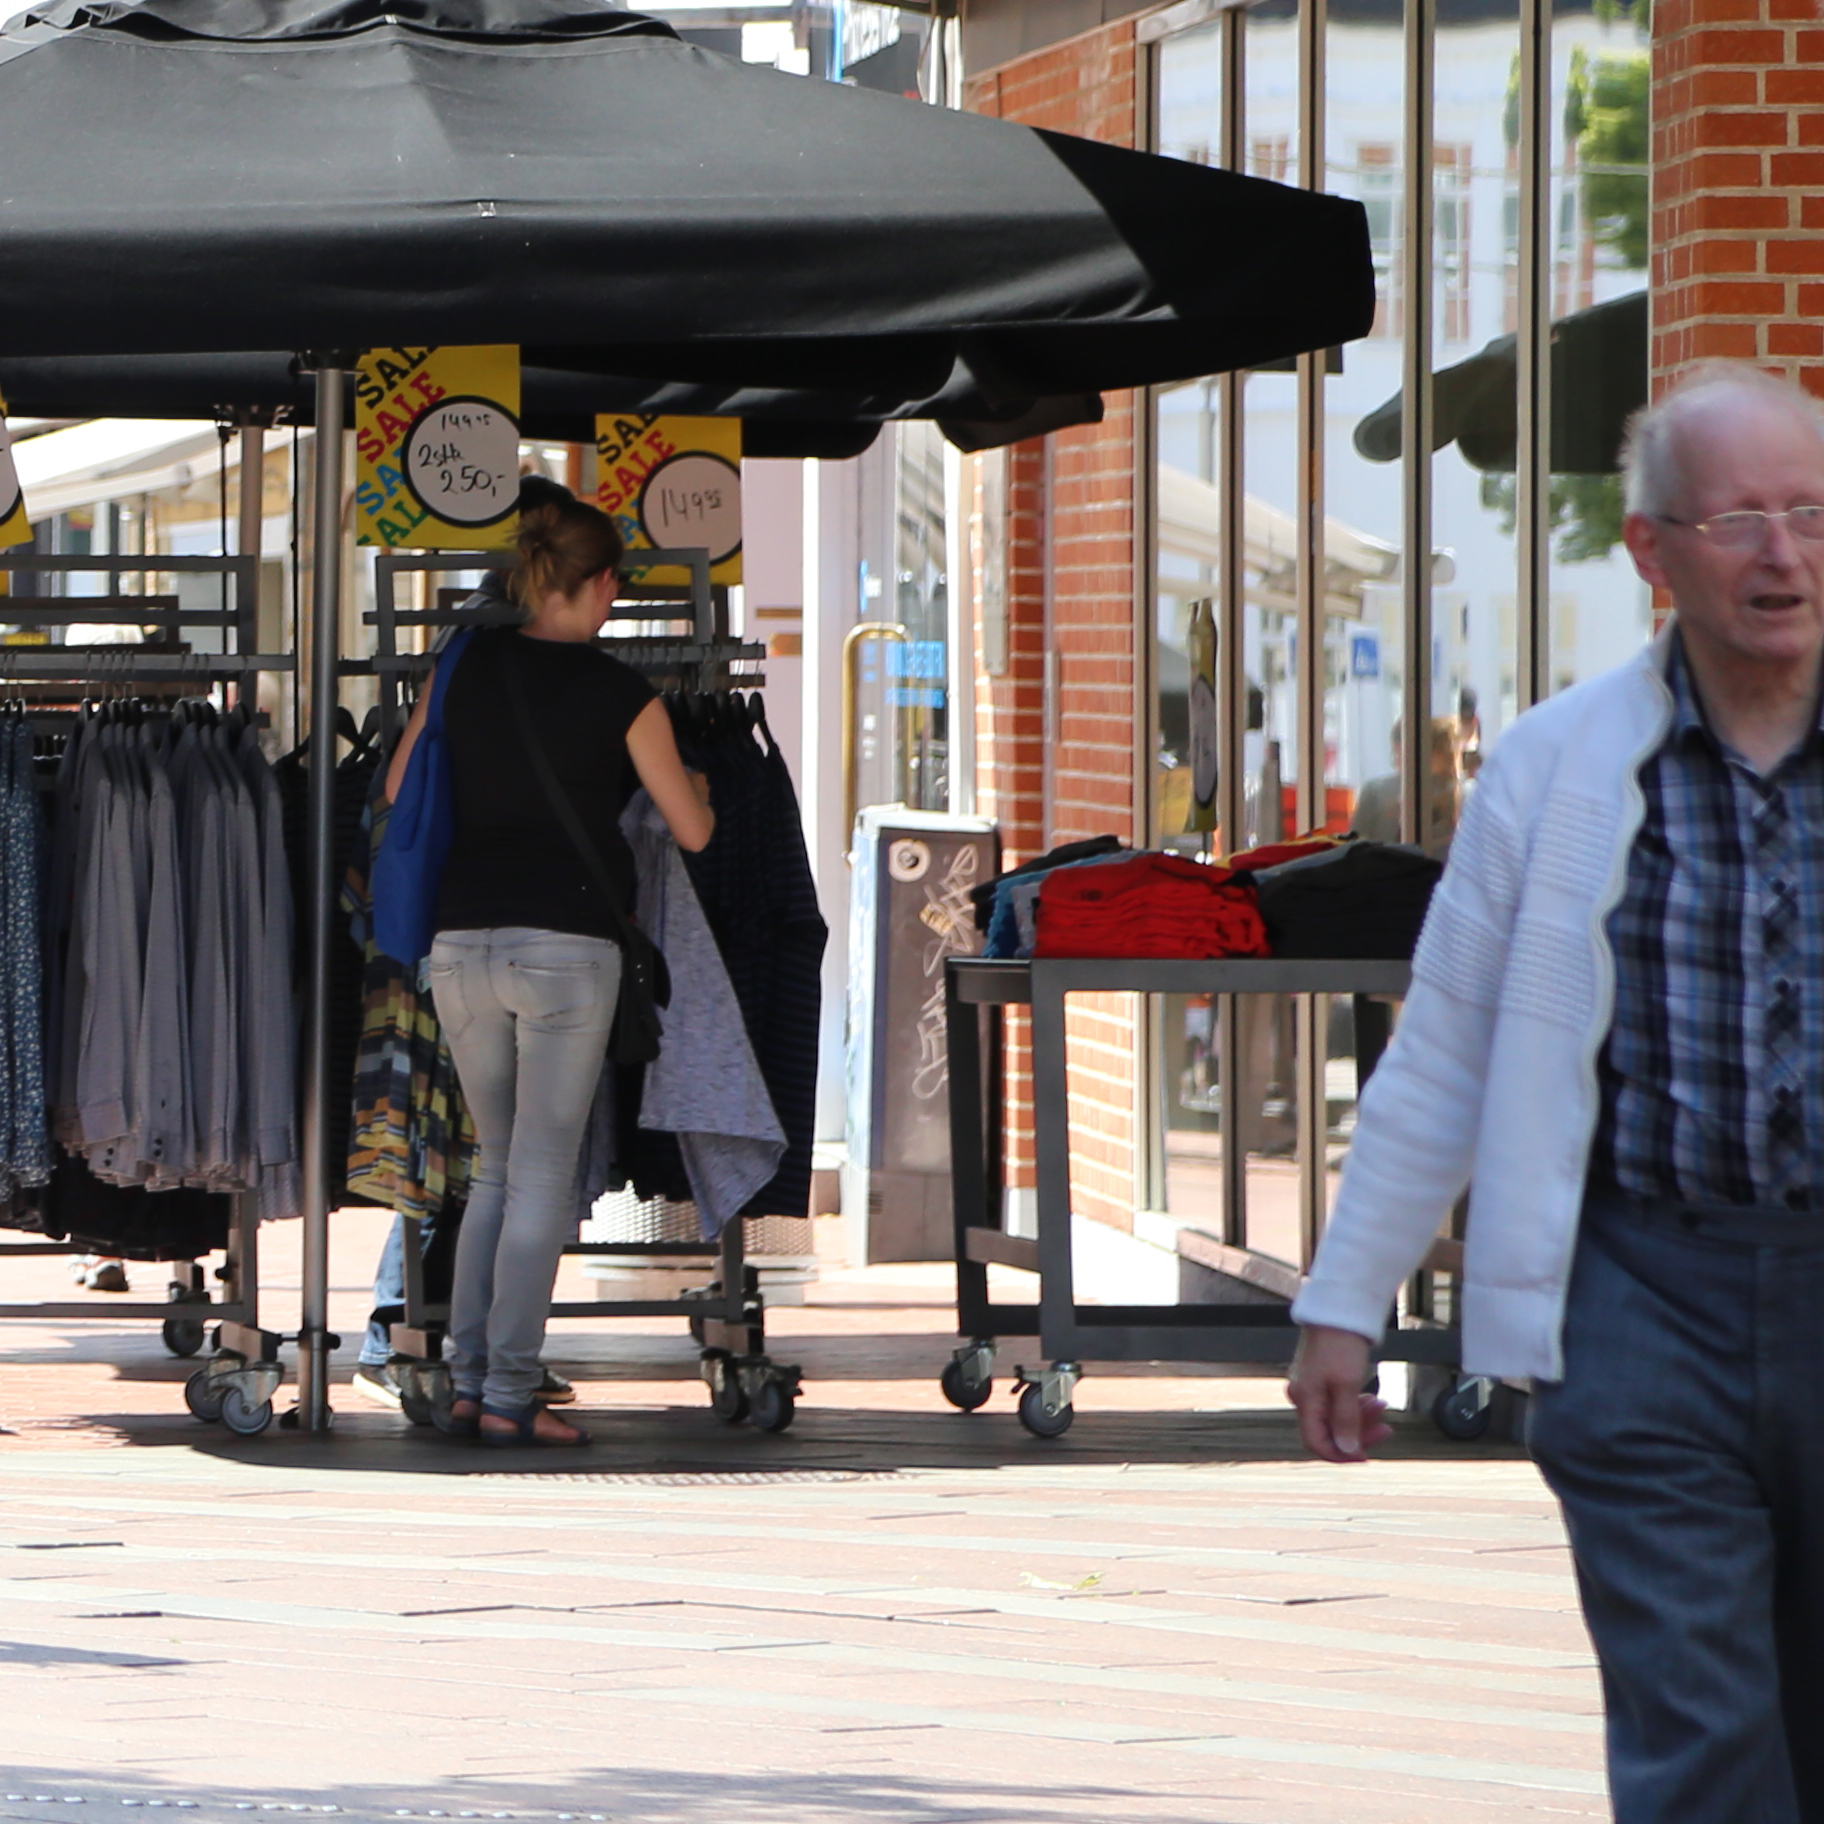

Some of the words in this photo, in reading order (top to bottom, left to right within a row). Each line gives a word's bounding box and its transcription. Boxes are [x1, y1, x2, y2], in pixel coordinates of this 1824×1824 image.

[356, 347, 439, 409] SAL
[357, 371, 446, 463] SALE
[597, 429, 675, 513] SALE
